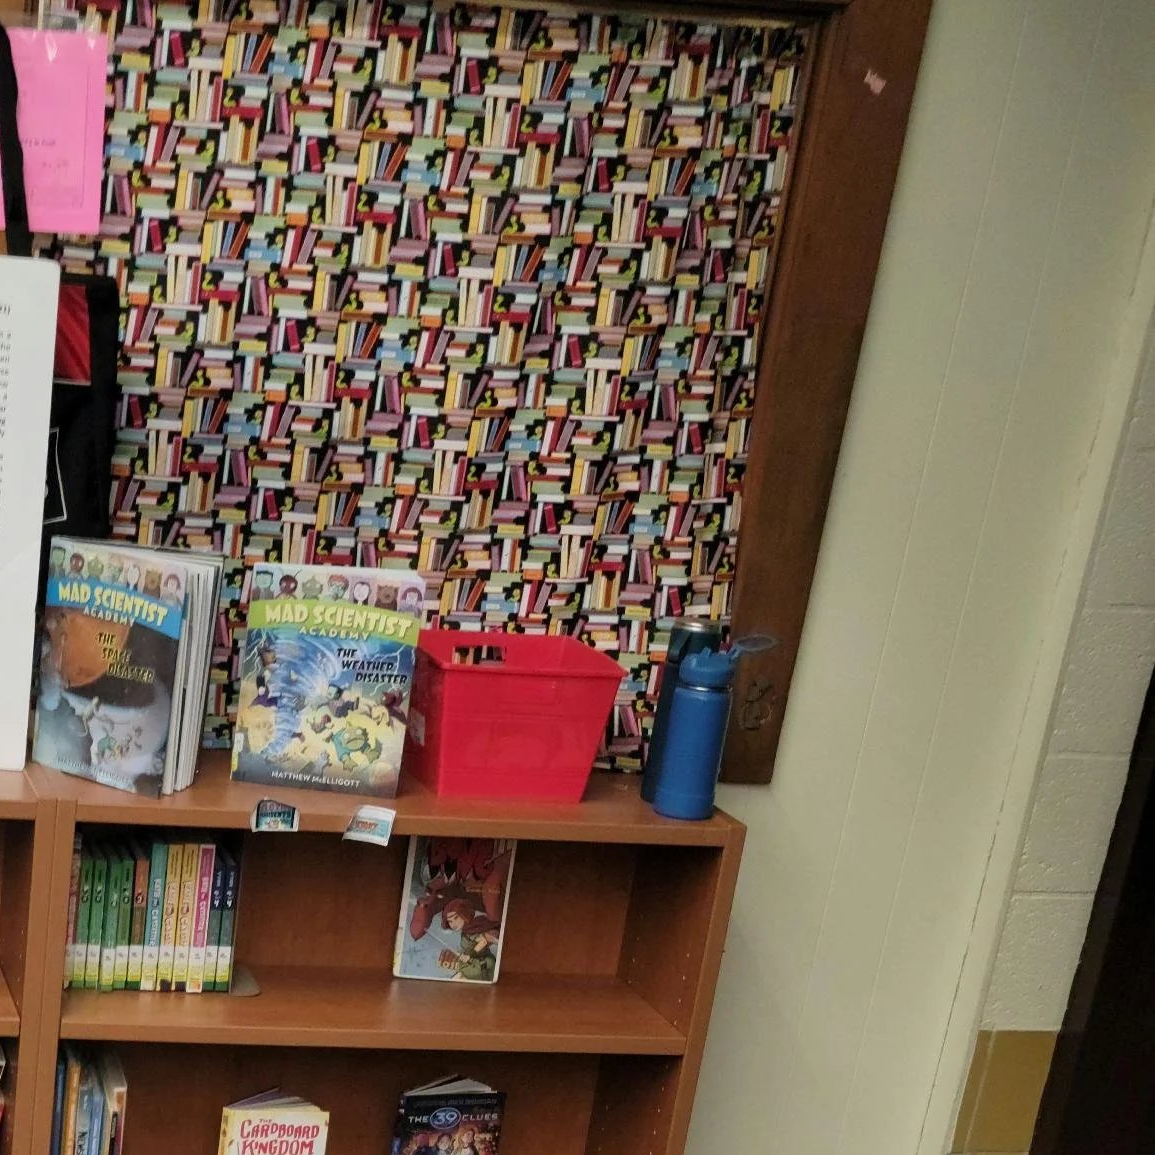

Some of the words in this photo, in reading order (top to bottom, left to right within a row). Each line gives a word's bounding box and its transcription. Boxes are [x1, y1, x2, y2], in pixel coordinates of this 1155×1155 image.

[59, 583, 91, 603] MAD
[95, 588, 167, 626] SCIENTIST
[84, 607, 135, 627] ACADEMY
[265, 604, 308, 624] MAD
[314, 607, 412, 637] SCIENTIST
[97, 632, 114, 645] THE
[300, 627, 370, 641] ACADEMY
[336, 648, 358, 659] THE
[107, 664, 155, 684] DISASTER
[341, 660, 394, 673] WEATHER
[355, 673, 408, 686] DISASTER
[271, 771, 310, 782] MATTHEW
[408, 1116, 428, 1124] THE
[435, 1108, 458, 1126] 39
[461, 1113, 498, 1122] CLUES
[239, 1119, 320, 1139] CARDBOARD
